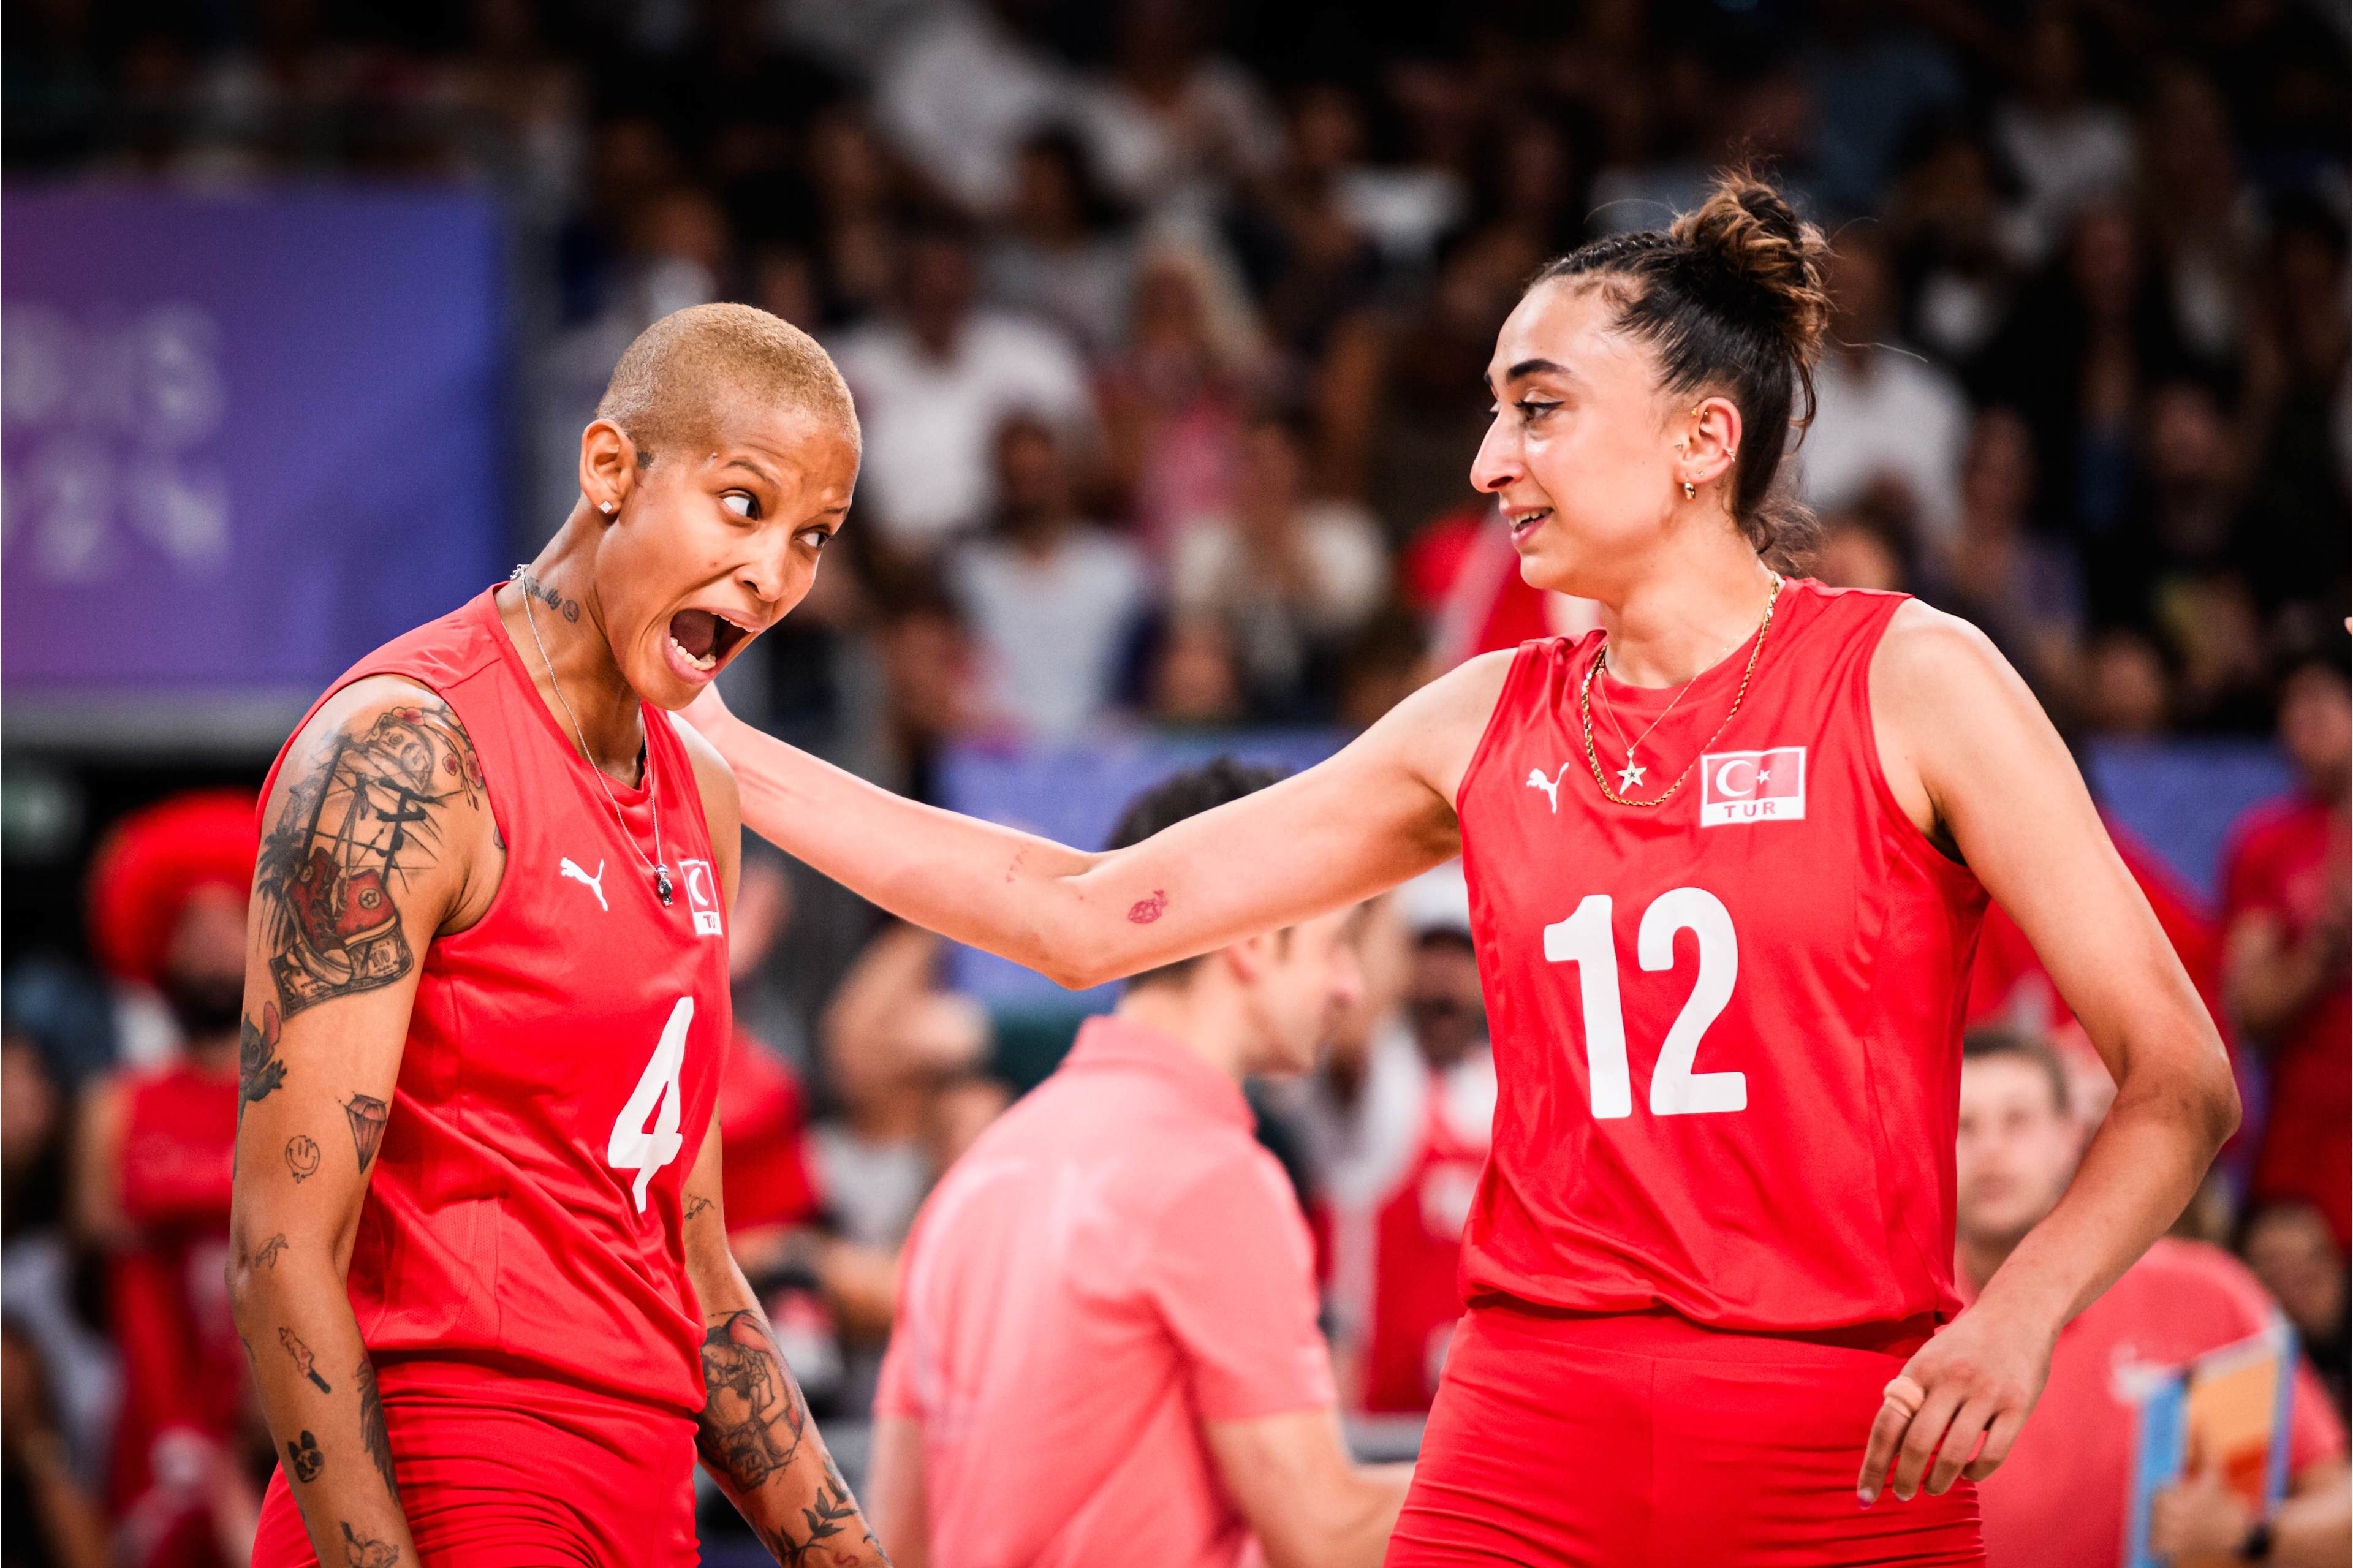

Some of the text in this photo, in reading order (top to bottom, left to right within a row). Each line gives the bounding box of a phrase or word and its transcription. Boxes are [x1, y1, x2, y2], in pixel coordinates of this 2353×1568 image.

[1724, 801, 1776, 818] TUR
[607, 996, 694, 1214] 4
[1544, 887, 1748, 1119] 12
